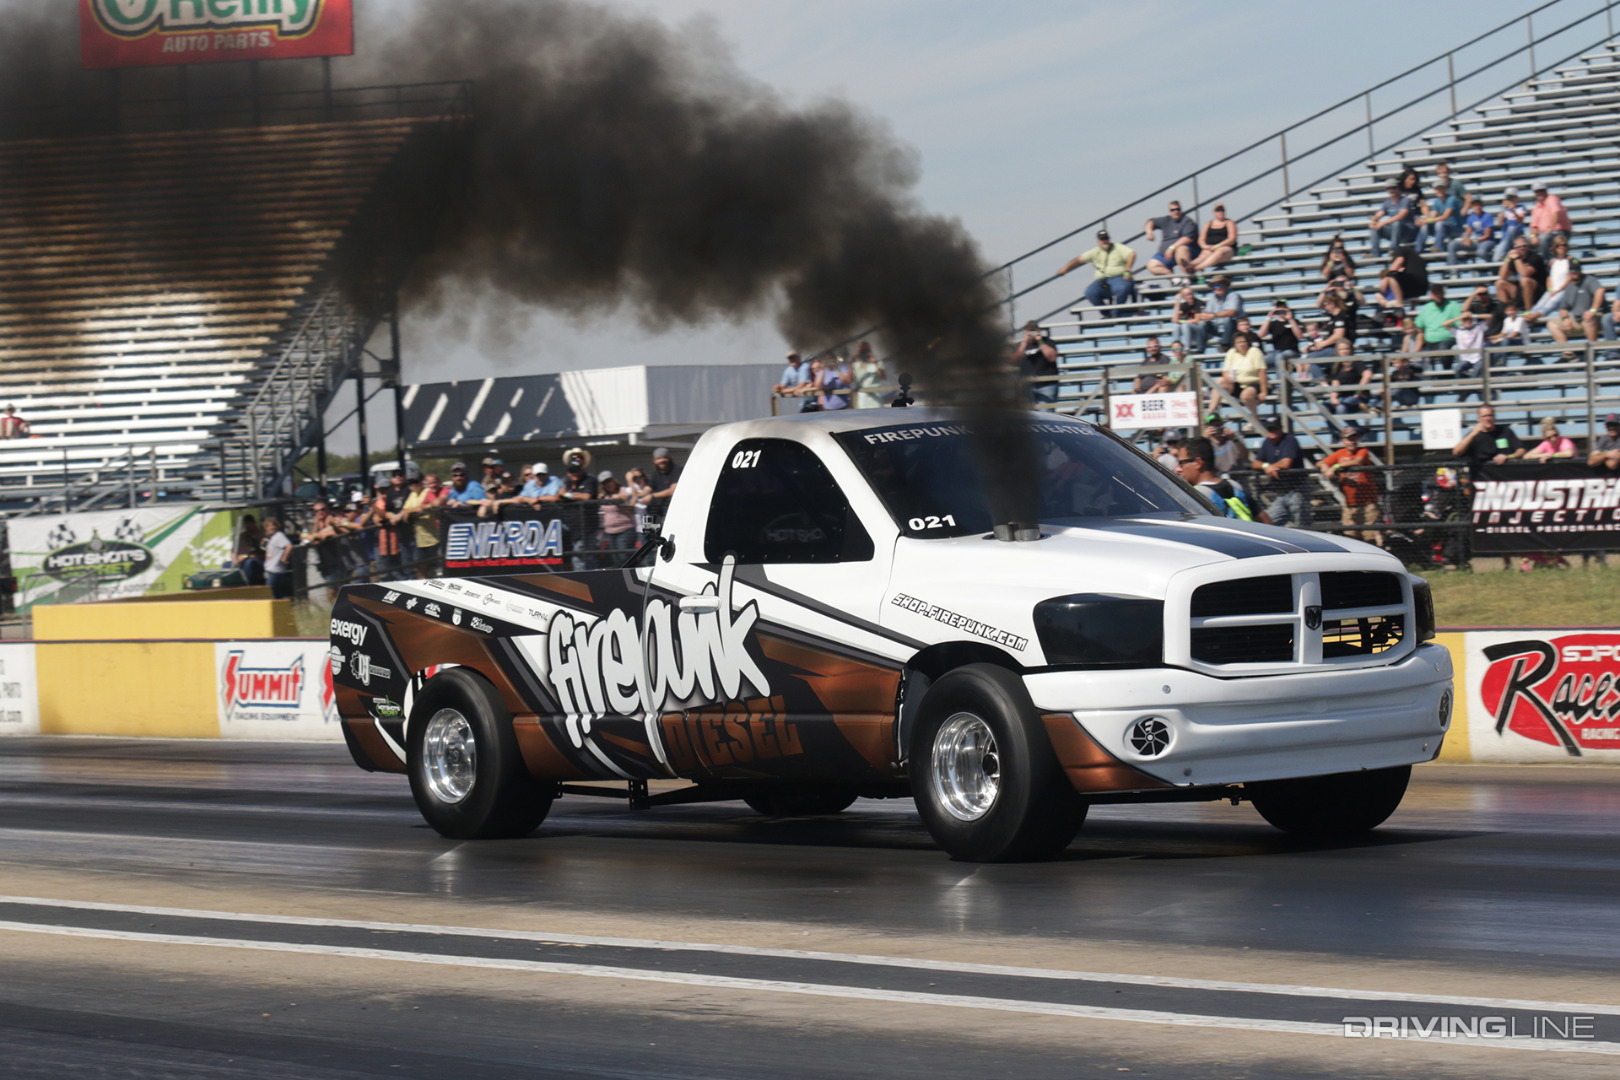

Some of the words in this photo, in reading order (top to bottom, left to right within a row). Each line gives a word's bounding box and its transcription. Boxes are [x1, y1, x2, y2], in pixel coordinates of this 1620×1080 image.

[162, 35, 208, 53] AUTO
[213, 31, 273, 50] PARTS
[1141, 399, 1165, 412] BEER
[863, 425, 974, 446] FIREPUNK
[732, 450, 761, 469] 021
[908, 514, 956, 531] 021
[1486, 526, 1531, 534] DIESEL
[446, 519, 563, 560] NHRDA
[330, 618, 368, 646] exergy
[891, 592, 1029, 652] SHOP.FIREPUNK.COM
[549, 554, 771, 764] firepunk
[660, 695, 804, 771] DIESEL
